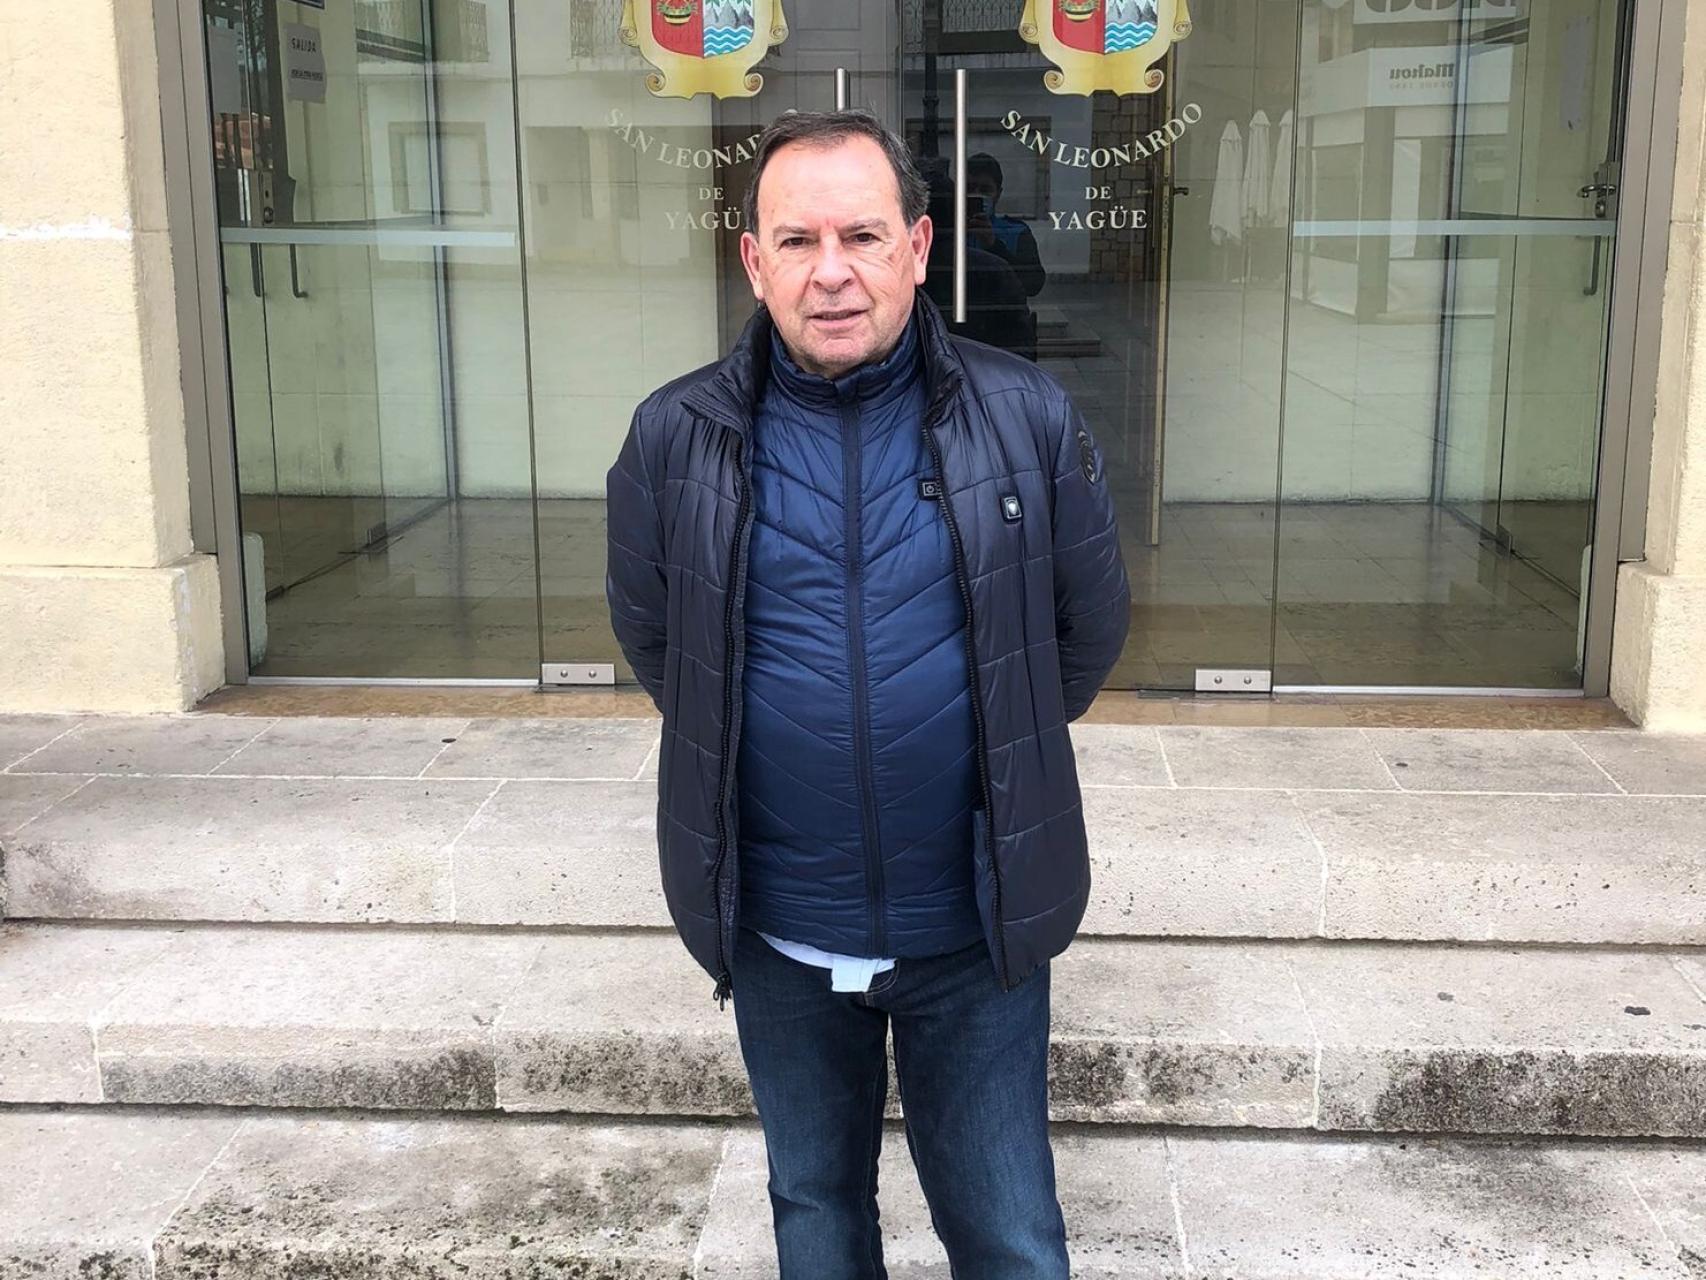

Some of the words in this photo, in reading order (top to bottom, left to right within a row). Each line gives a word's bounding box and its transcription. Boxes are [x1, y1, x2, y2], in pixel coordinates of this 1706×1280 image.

[608, 108, 654, 152] SAN
[1001, 110, 1052, 155] SAN
[1054, 103, 1202, 168] LEONARDO
[699, 187, 724, 200] DE
[1085, 187, 1111, 200] DE
[665, 206, 748, 230] YAGÜ
[1049, 206, 1147, 230] YAGÜE
